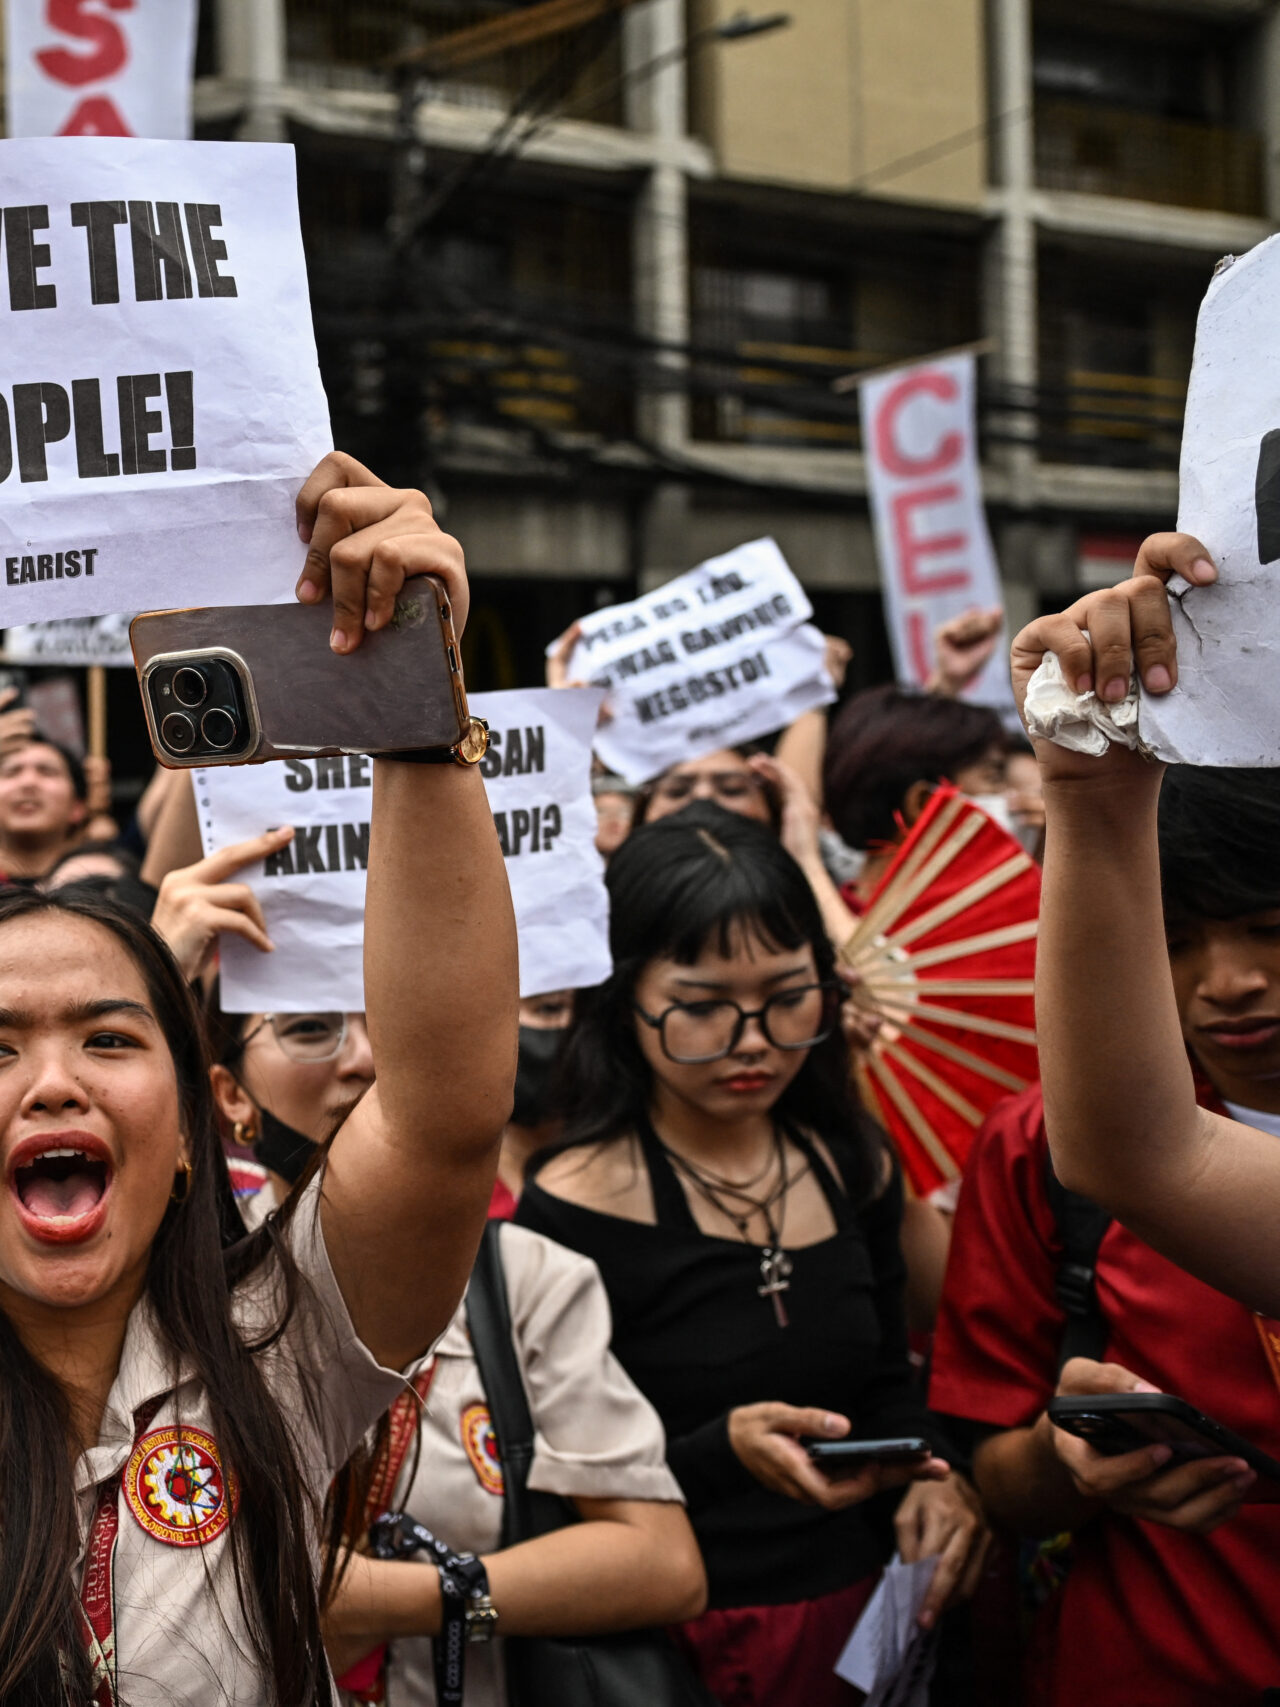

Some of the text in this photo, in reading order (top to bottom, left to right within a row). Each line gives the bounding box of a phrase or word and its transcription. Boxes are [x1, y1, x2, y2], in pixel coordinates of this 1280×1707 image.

[71, 200, 238, 306] THE
[5, 548, 99, 586] EARIST
[633, 651, 772, 725] NEGOSYO!
[86, 1503, 113, 1603] EULOGIO
